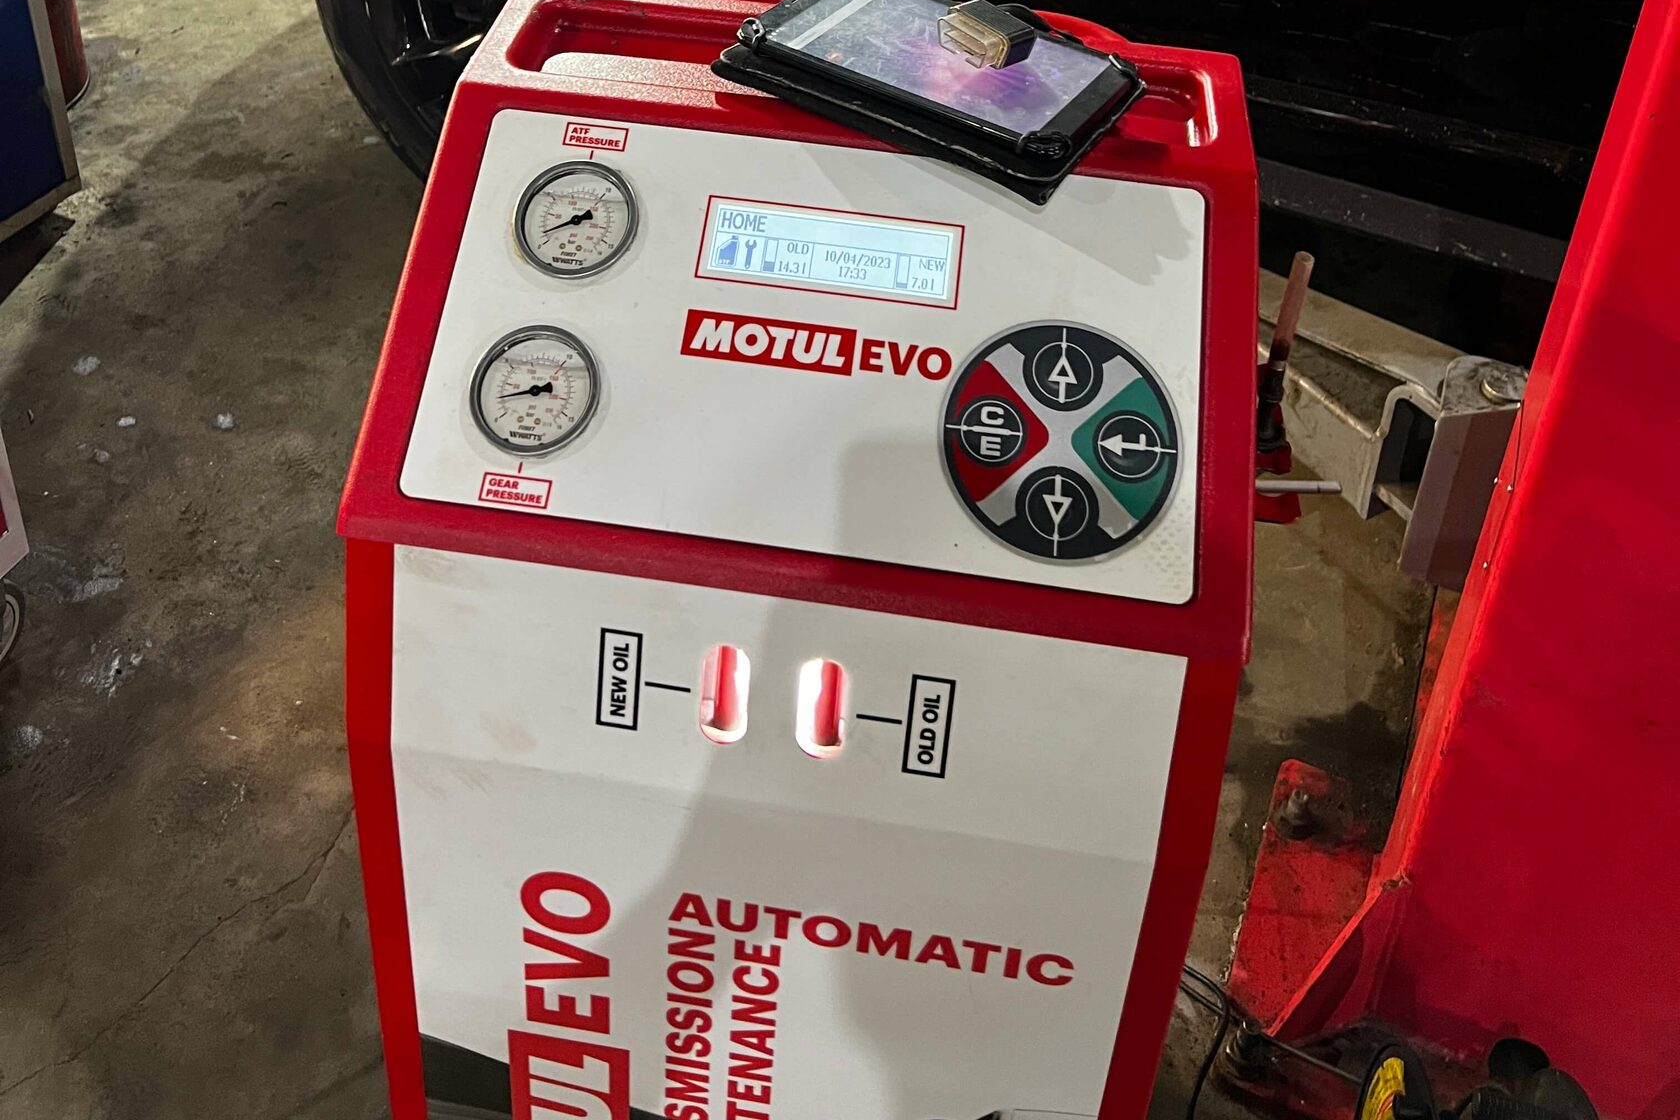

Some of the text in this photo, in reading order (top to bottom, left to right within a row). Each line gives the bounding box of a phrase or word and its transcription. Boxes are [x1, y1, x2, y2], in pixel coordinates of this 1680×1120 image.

[571, 127, 590, 136] ATF
[569, 135, 621, 147] PRESSURE
[720, 211, 767, 233] HOME
[787, 242, 809, 255] OLD
[824, 249, 891, 268] 10/04/2023
[918, 258, 946, 272] NEW
[837, 266, 867, 280] 17:33
[689, 317, 952, 381] MOTUL EVO
[488, 478, 519, 490] GEAR
[485, 489, 543, 505] PRESSURE
[610, 643, 631, 717] NEW OIL
[917, 694, 942, 765] OLD OIL
[668, 892, 1075, 987] AUTOMATIC
[519, 870, 612, 1036] EVO
